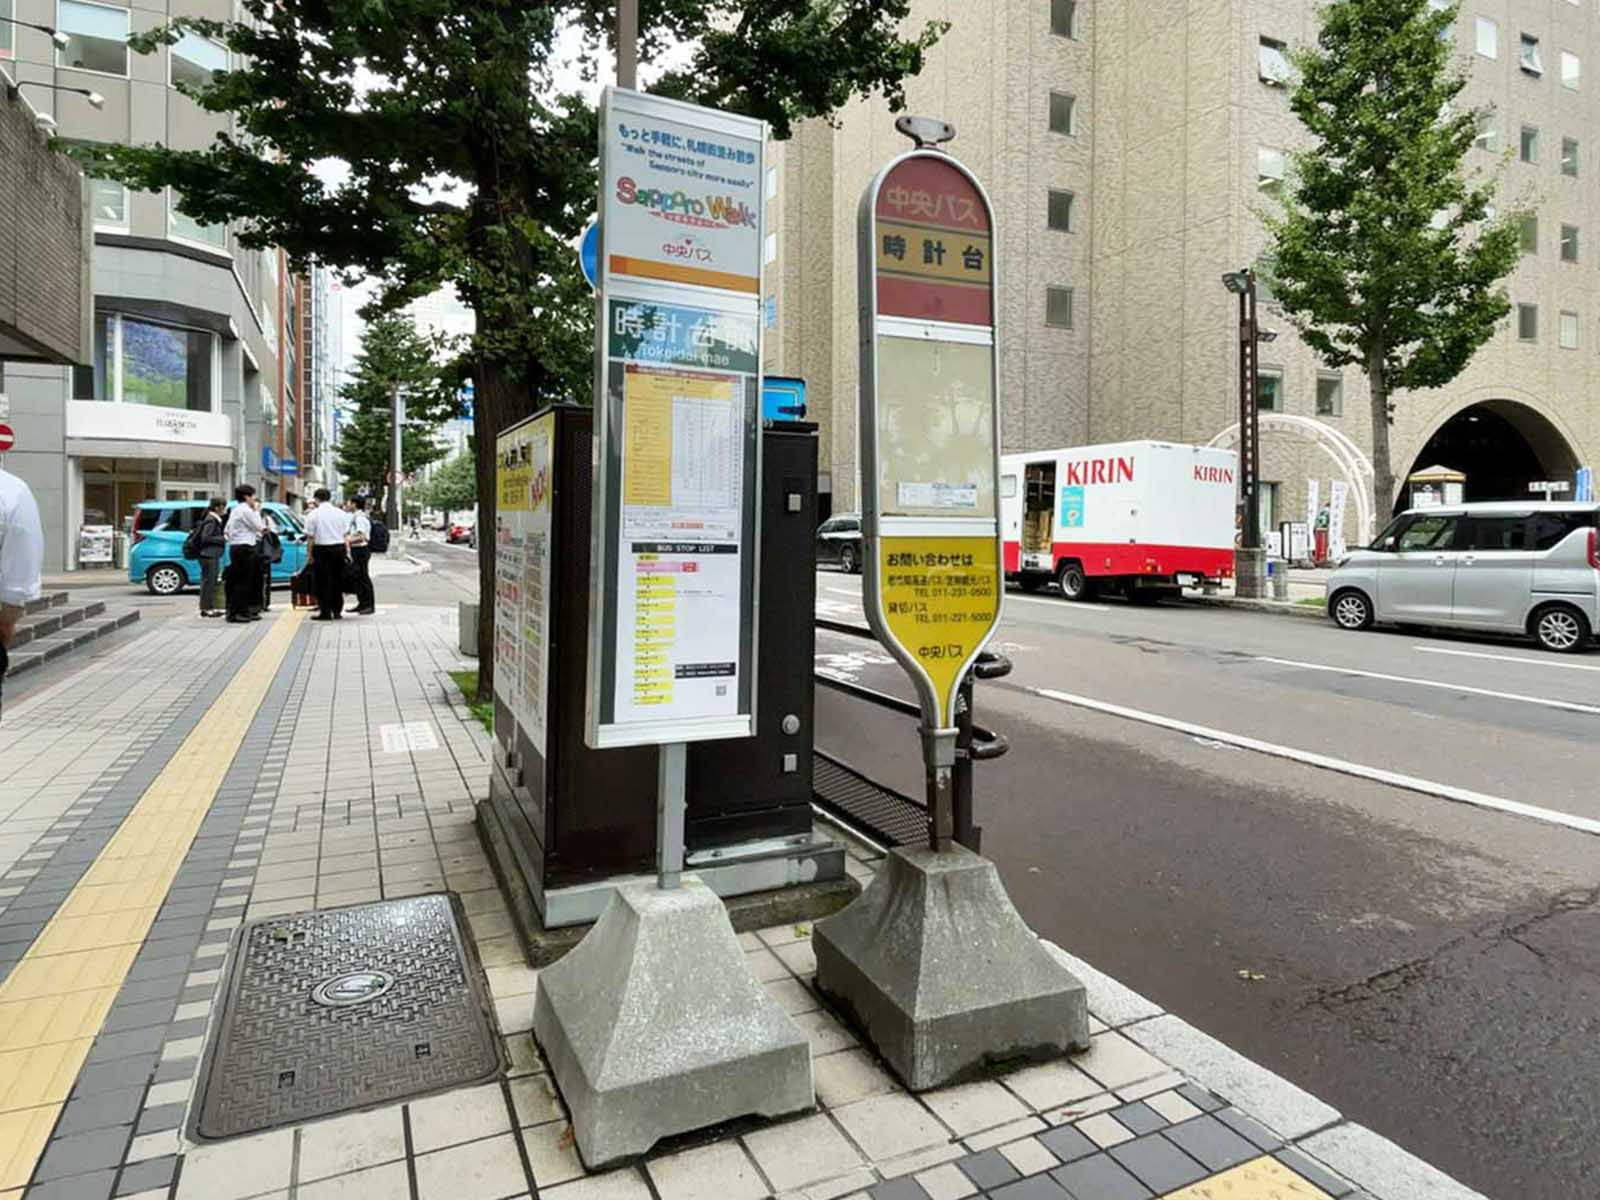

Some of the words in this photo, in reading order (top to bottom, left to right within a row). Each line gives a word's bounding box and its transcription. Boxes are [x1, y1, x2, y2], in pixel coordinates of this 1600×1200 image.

[706, 195, 756, 229] Walk
[885, 188, 979, 225] 中央バス
[662, 243, 713, 262] 中央バス
[883, 235, 984, 271] 時計台
[1067, 456, 1135, 486] KIRIN
[1193, 465, 1234, 484] KIRIN
[657, 544, 673, 552] BUS
[676, 544, 697, 552] STOP
[698, 544, 715, 552] LIST
[887, 553, 973, 567] お問い合わせは
[918, 644, 964, 658] 中央バス
